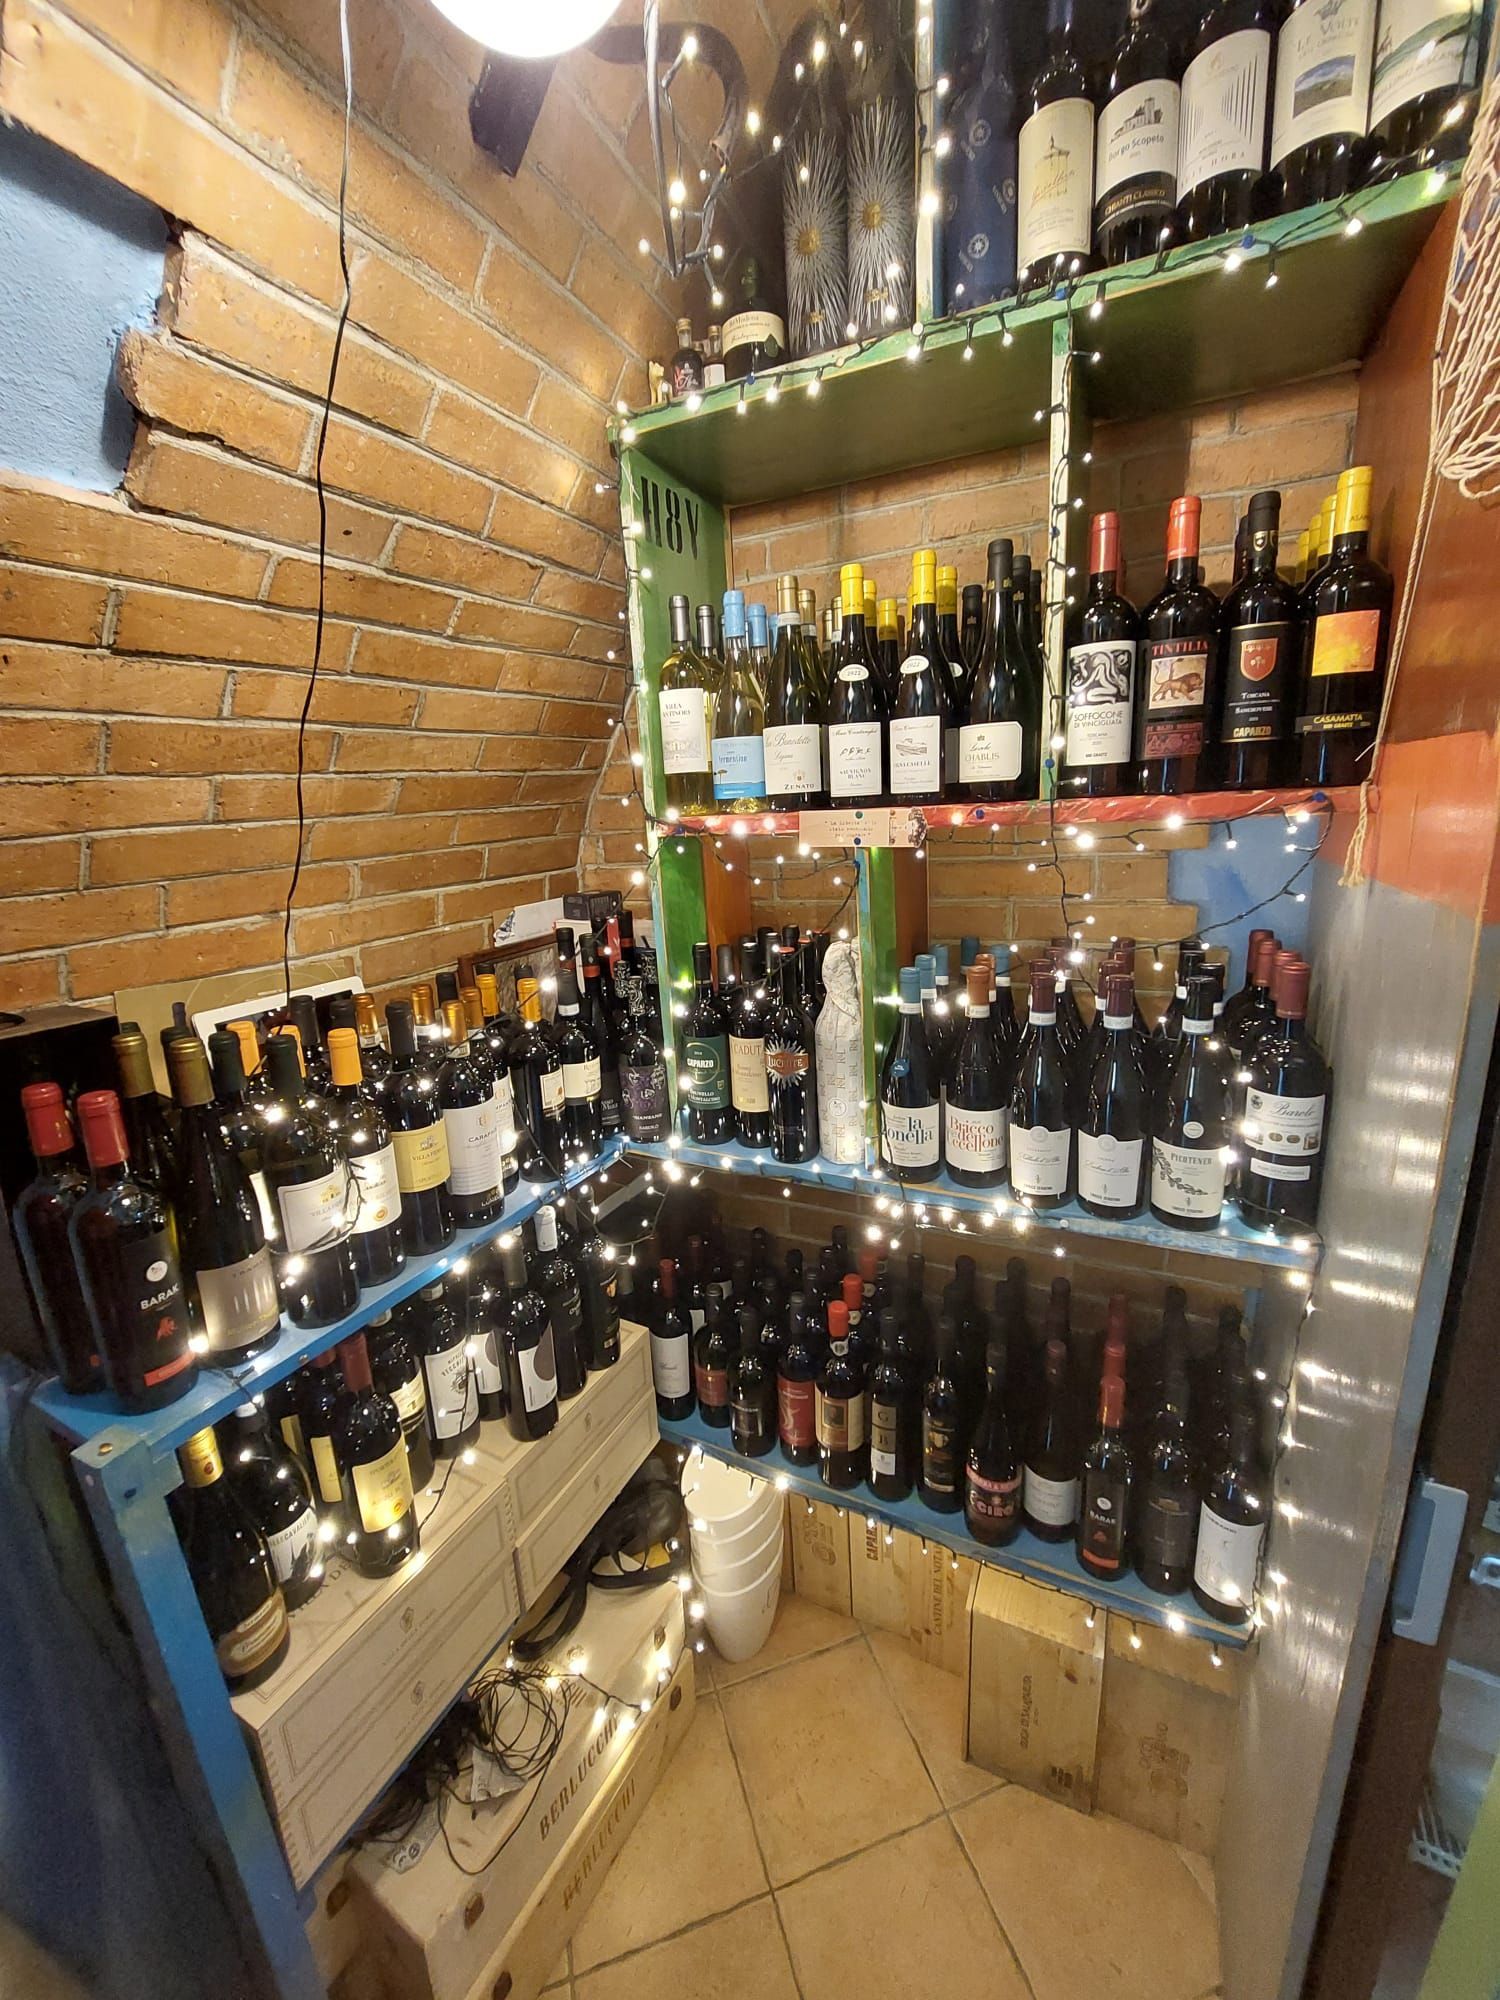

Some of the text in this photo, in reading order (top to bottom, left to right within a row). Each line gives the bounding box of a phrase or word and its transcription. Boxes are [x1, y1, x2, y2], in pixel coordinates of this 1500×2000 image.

[1132, 134, 1164, 149] Scopeto
[1152, 640, 1208, 656] TINTILIA
[1074, 710, 1123, 721] SOFFOCONE
[1313, 713, 1363, 724] CASAMATTA
[1081, 719, 1123, 729] VINCIGLIATA
[1232, 725, 1272, 738] CAPARZO
[964, 751, 1000, 762] CHABLIS
[784, 783, 815, 791] ZENATO
[687, 1058, 714, 1068] CAPARZO
[1270, 1101, 1315, 1117] Barolo
[907, 1116, 922, 1131] la
[950, 1115, 994, 1134] Bricco
[883, 1127, 933, 1145] onella
[412, 1152, 431, 1163] VILLA
[1170, 1152, 1212, 1166] PICOTENER
[140, 1282, 180, 1311] BARAK
[1089, 1509, 1117, 1526] BARAK
[866, 1524, 879, 1561] CAPAR
[933, 1578, 944, 1598] DEL
[933, 1598, 944, 1636] CANTINE
[540, 1716, 620, 1842] BERLUCCHI
[562, 1778, 636, 1912] BERLUCCHI
